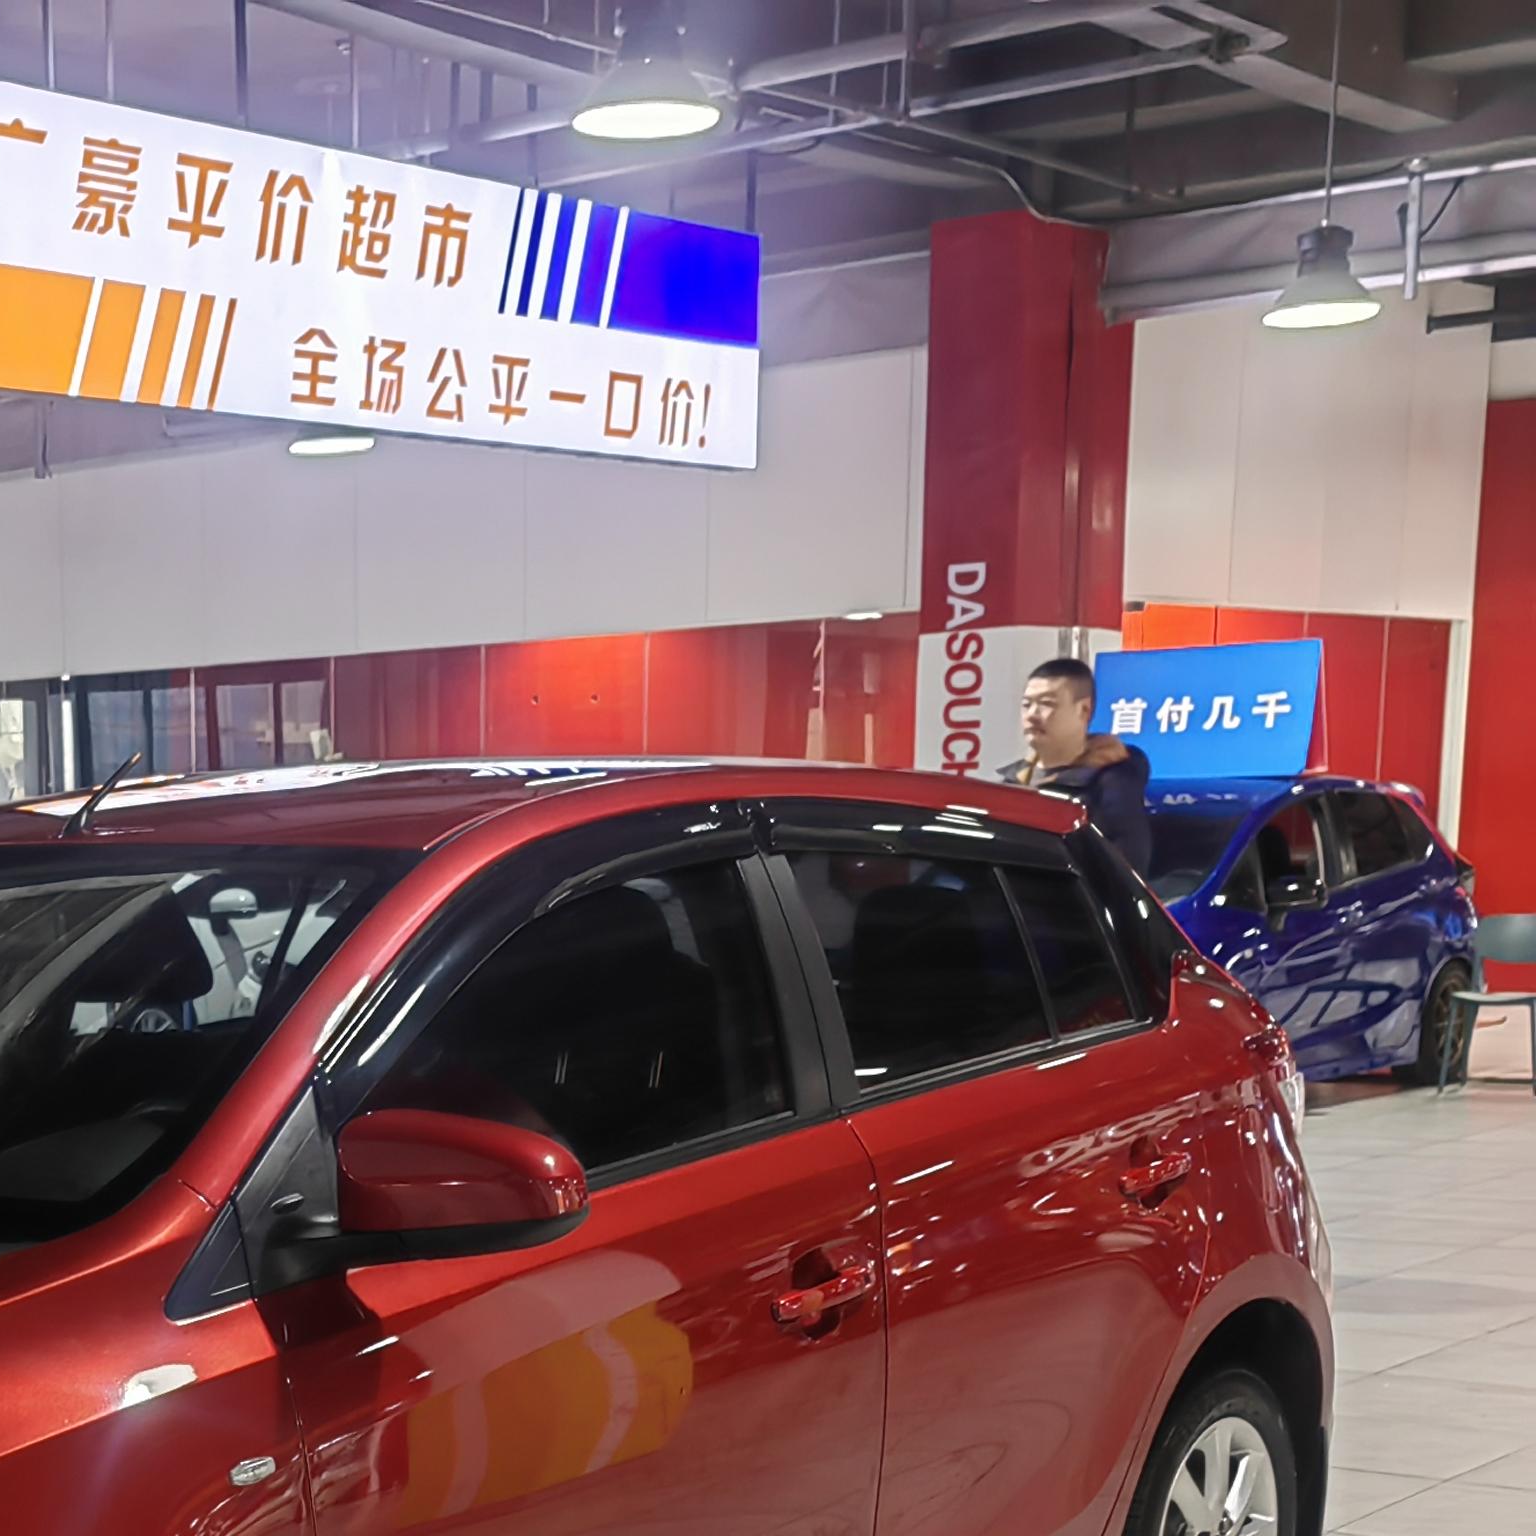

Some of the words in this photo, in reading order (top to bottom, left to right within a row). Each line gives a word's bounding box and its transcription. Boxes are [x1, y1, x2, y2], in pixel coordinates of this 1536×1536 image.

[290, 326, 712, 449] 全场公平一口价!
[1110, 691, 1292, 735] 首付几千
